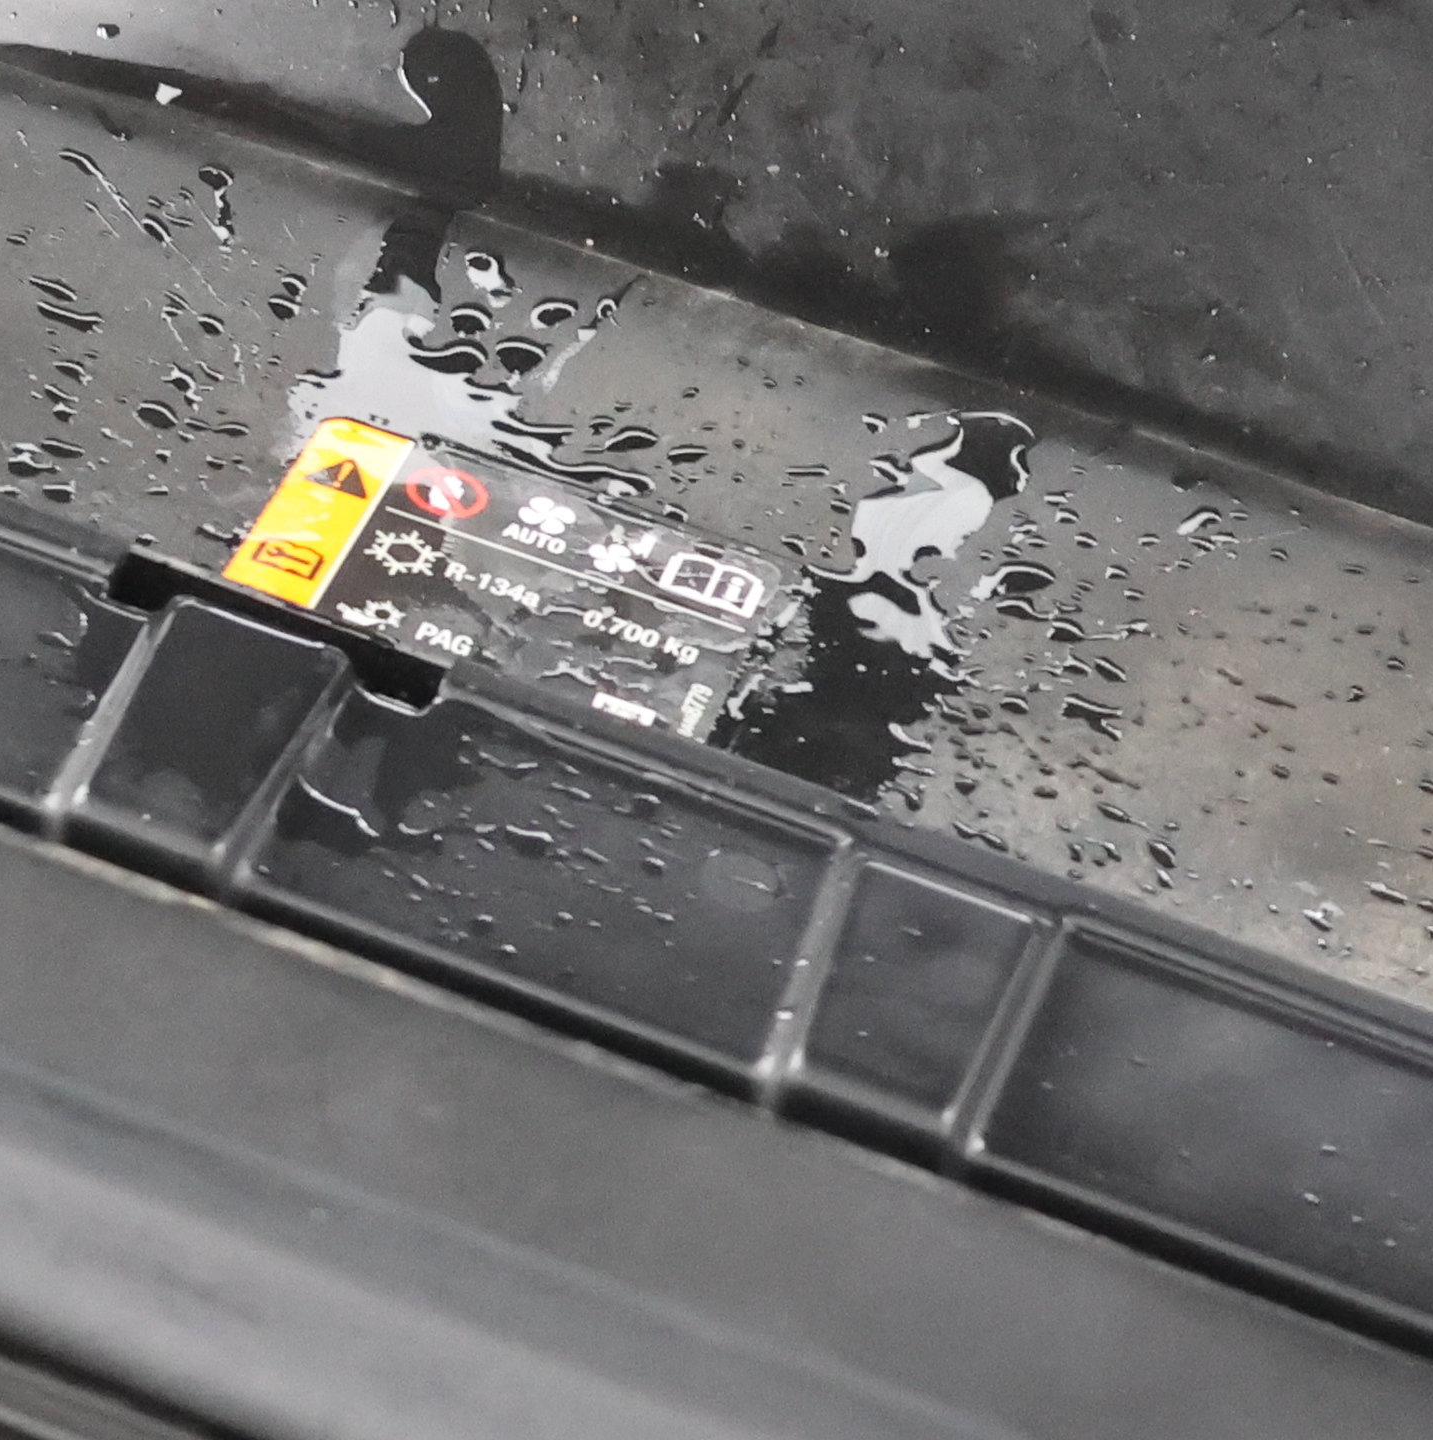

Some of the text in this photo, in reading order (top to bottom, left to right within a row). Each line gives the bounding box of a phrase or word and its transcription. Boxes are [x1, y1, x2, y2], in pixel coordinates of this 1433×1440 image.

[501, 522, 566, 554] AUTO
[444, 561, 541, 609] R-134a
[583, 609, 661, 648] 0.700
[414, 621, 474, 656] PAG
